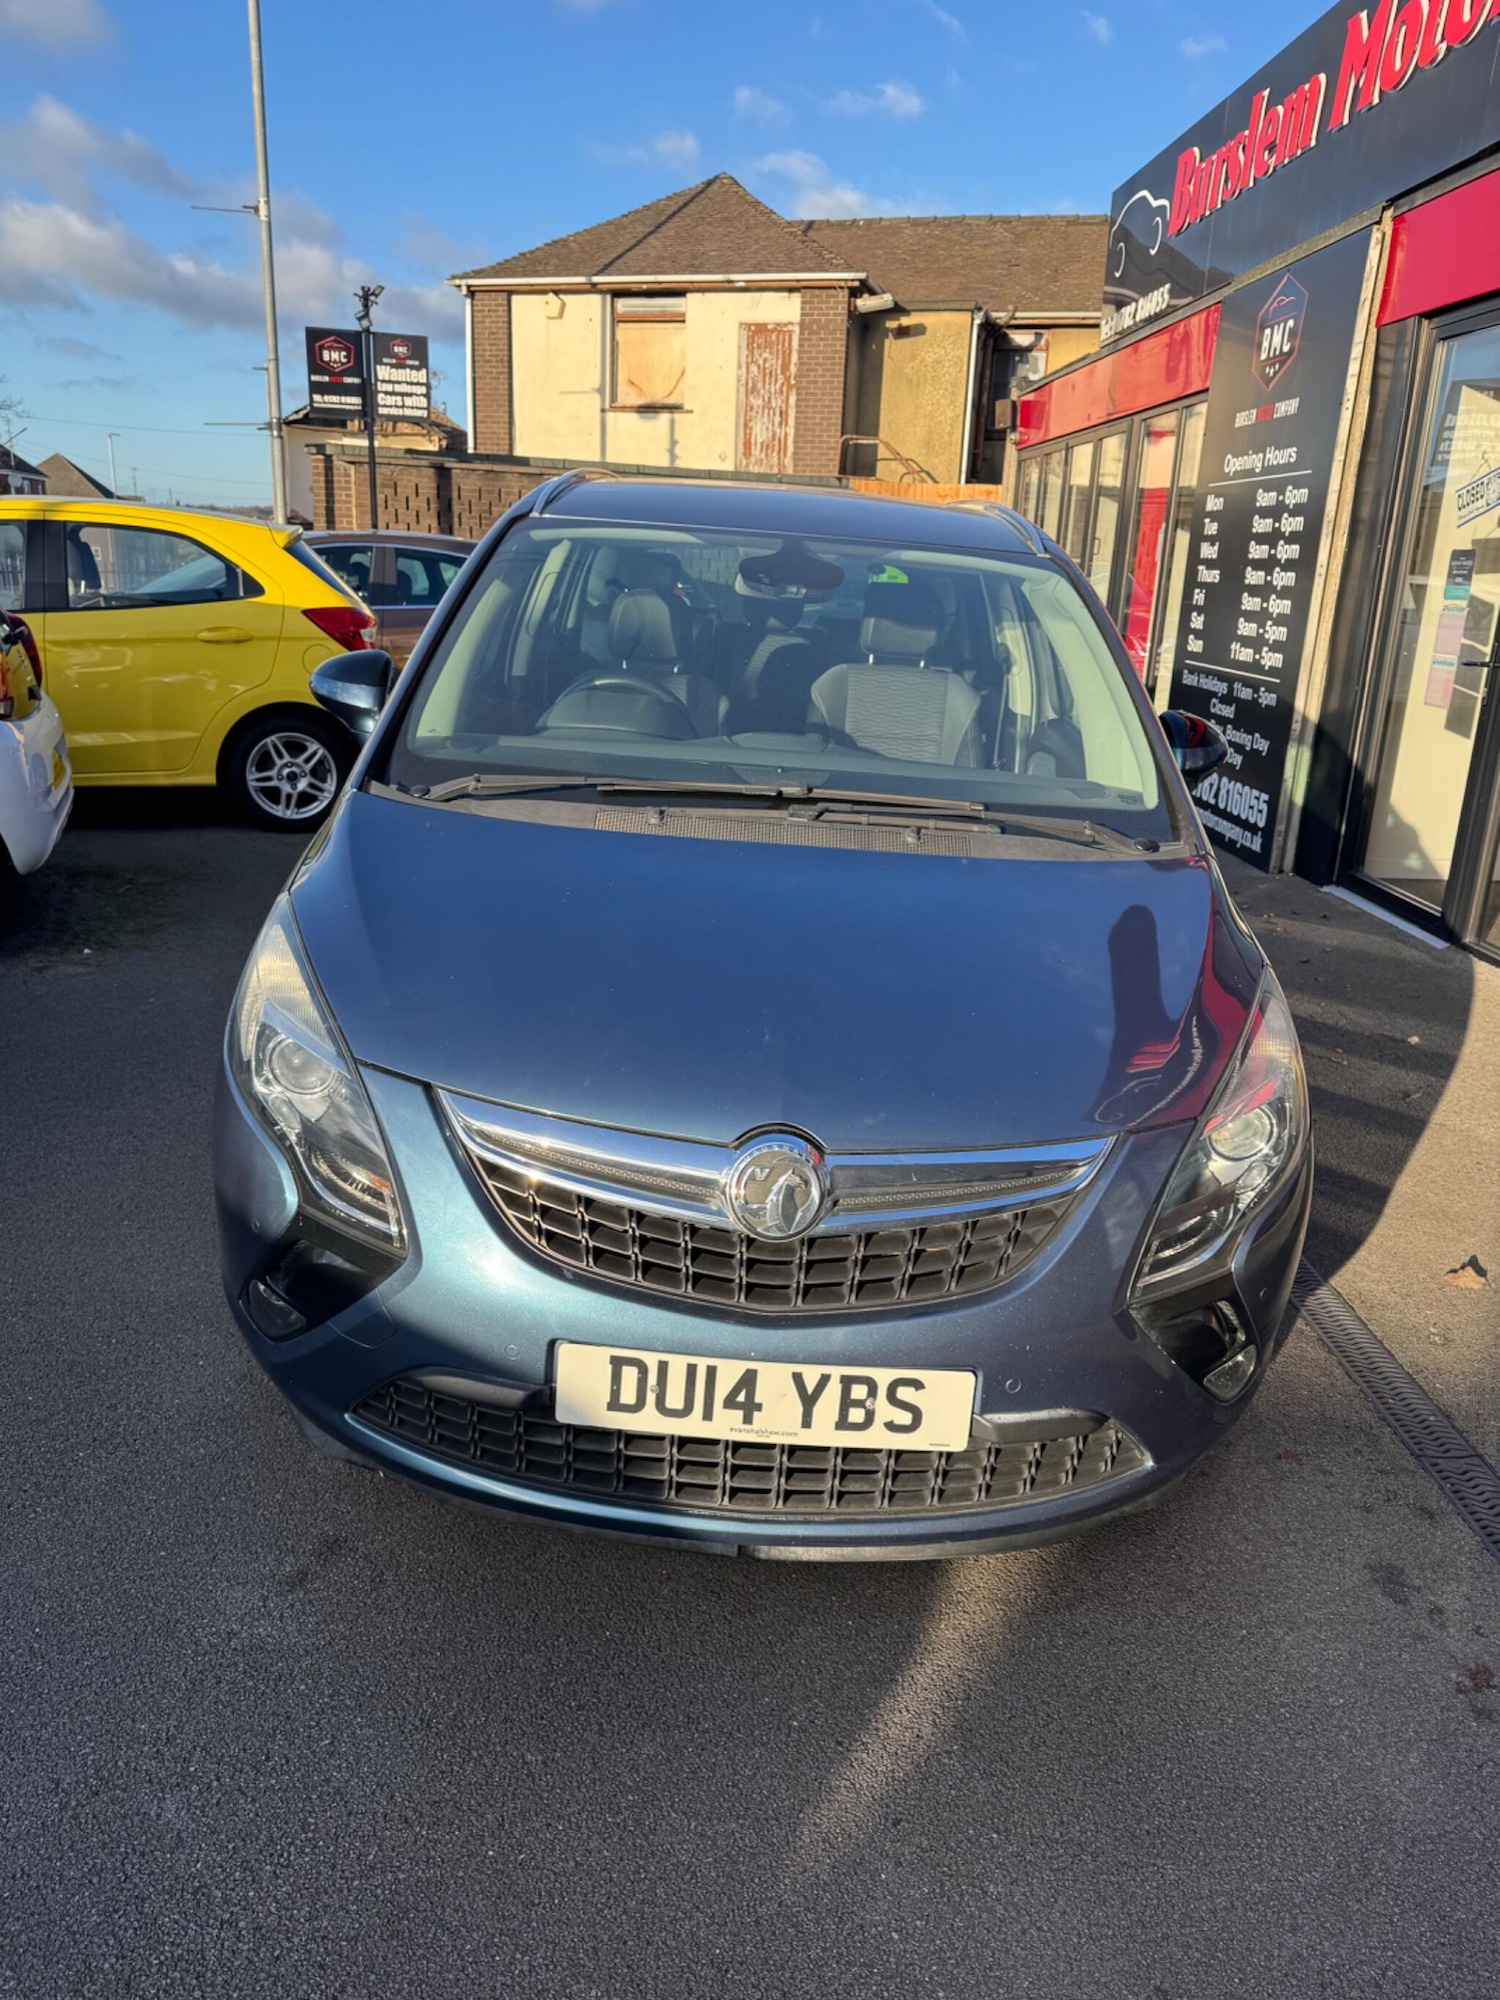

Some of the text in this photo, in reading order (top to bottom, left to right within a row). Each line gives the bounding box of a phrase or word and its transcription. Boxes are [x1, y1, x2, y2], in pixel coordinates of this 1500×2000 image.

[1166, 0, 1500, 238] Burslem Moto
[1260, 318, 1295, 361] BMC
[322, 349, 348, 363] BMC
[376, 365, 427, 383] Wanted
[377, 381, 393, 392] Low
[377, 393, 403, 406] Cars
[403, 395, 428, 408] with
[1224, 445, 1298, 477] Opening Hours
[1205, 494, 1224, 512] Mon
[1256, 488, 1277, 507] 9am
[1285, 485, 1308, 509] 6pm
[1458, 481, 1485, 511] CLOSED
[1203, 518, 1219, 536] Tue
[1252, 514, 1273, 533] 9am
[1281, 512, 1304, 537] 6pm
[1200, 541, 1219, 559] Wed
[1248, 540, 1269, 559] 9am
[1276, 539, 1300, 564] 6pm
[1197, 565, 1220, 583] Thurs
[1244, 566, 1265, 585] 9am
[1272, 566, 1296, 591] 6pm
[1192, 588, 1206, 606] Fri
[1241, 592, 1261, 612] 9am
[1268, 594, 1291, 618] 6pm
[1190, 611, 1205, 630] Sat
[1237, 617, 1258, 637] 9am
[1264, 620, 1287, 644] 5pm
[1187, 634, 1203, 653] Sun
[1230, 641, 1254, 662] 11am
[1260, 646, 1283, 670] 5pm
[1182, 669, 1198, 687] Bank
[1198, 673, 1228, 697] Holidays
[1233, 681, 1253, 701] 11am
[1258, 687, 1277, 708] 5pm
[1210, 697, 1236, 719] Closed
[1225, 724, 1253, 751] Boxing
[1253, 732, 1270, 756] Day
[1227, 747, 1243, 770] Day
[1218, 776, 1270, 828] 816055
[606, 1354, 926, 1435] DU14 YBS
